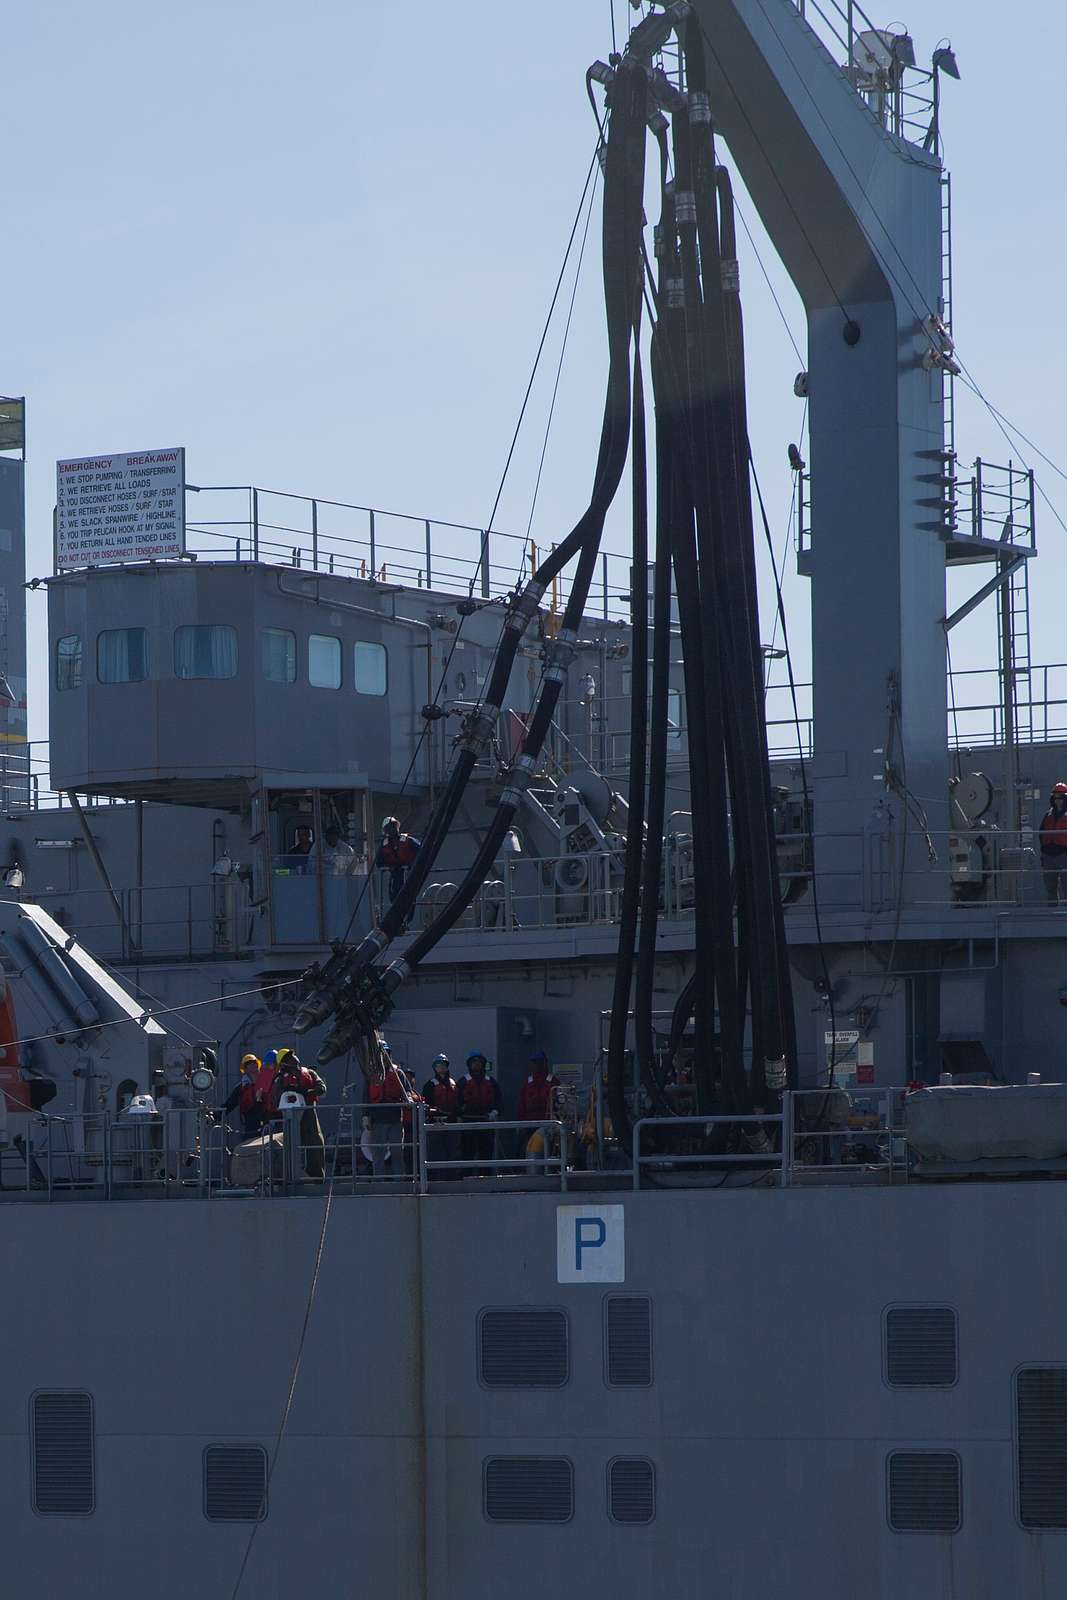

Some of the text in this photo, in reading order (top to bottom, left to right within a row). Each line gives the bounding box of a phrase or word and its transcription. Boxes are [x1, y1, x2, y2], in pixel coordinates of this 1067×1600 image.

[59, 453, 178, 473] EMERGENCY BREAKAWAY
[66, 476, 76, 484] WE
[78, 474, 93, 483] STOP
[96, 471, 122, 481] PUMPING
[130, 466, 176, 477] TRANSFERRING
[81, 483, 111, 493] RETRIEVE
[115, 481, 126, 490] ALL
[129, 479, 150, 489] LOADS
[67, 497, 78, 506] YOU
[80, 492, 115, 505] DISCONNECT
[117, 492, 136, 500] HOSES
[67, 508, 77, 517] WE
[79, 505, 106, 516] RETRIEVE
[108, 503, 128, 512] HOSES
[136, 501, 151, 510] SURF
[159, 500, 173, 509] STAR
[68, 520, 79, 528] WE
[81, 517, 102, 526] SLACK
[105, 513, 138, 525] SPANWIRE
[146, 510, 176, 519] HIGHLINE
[67, 530, 78, 539] YOU
[81, 529, 92, 537] TRIP
[94, 525, 116, 536] PELICAN
[118, 524, 134, 533] HOOK
[136, 523, 143, 531] AT
[146, 522, 153, 530] MY
[156, 520, 176, 530] SIGNAL
[67, 541, 78, 550] YOU
[80, 538, 103, 548] RETURN
[105, 537, 115, 545] ALL
[117, 535, 133, 545] HAND
[135, 534, 157, 543] TENDED
[160, 533, 176, 541] LINES
[69, 553, 79, 562] NOT
[80, 552, 90, 561] CUT
[93, 552, 100, 560] OR
[101, 548, 133, 559] DISCONNECT
[135, 546, 163, 556] TENSIONED
[576, 1218, 606, 1270] P
